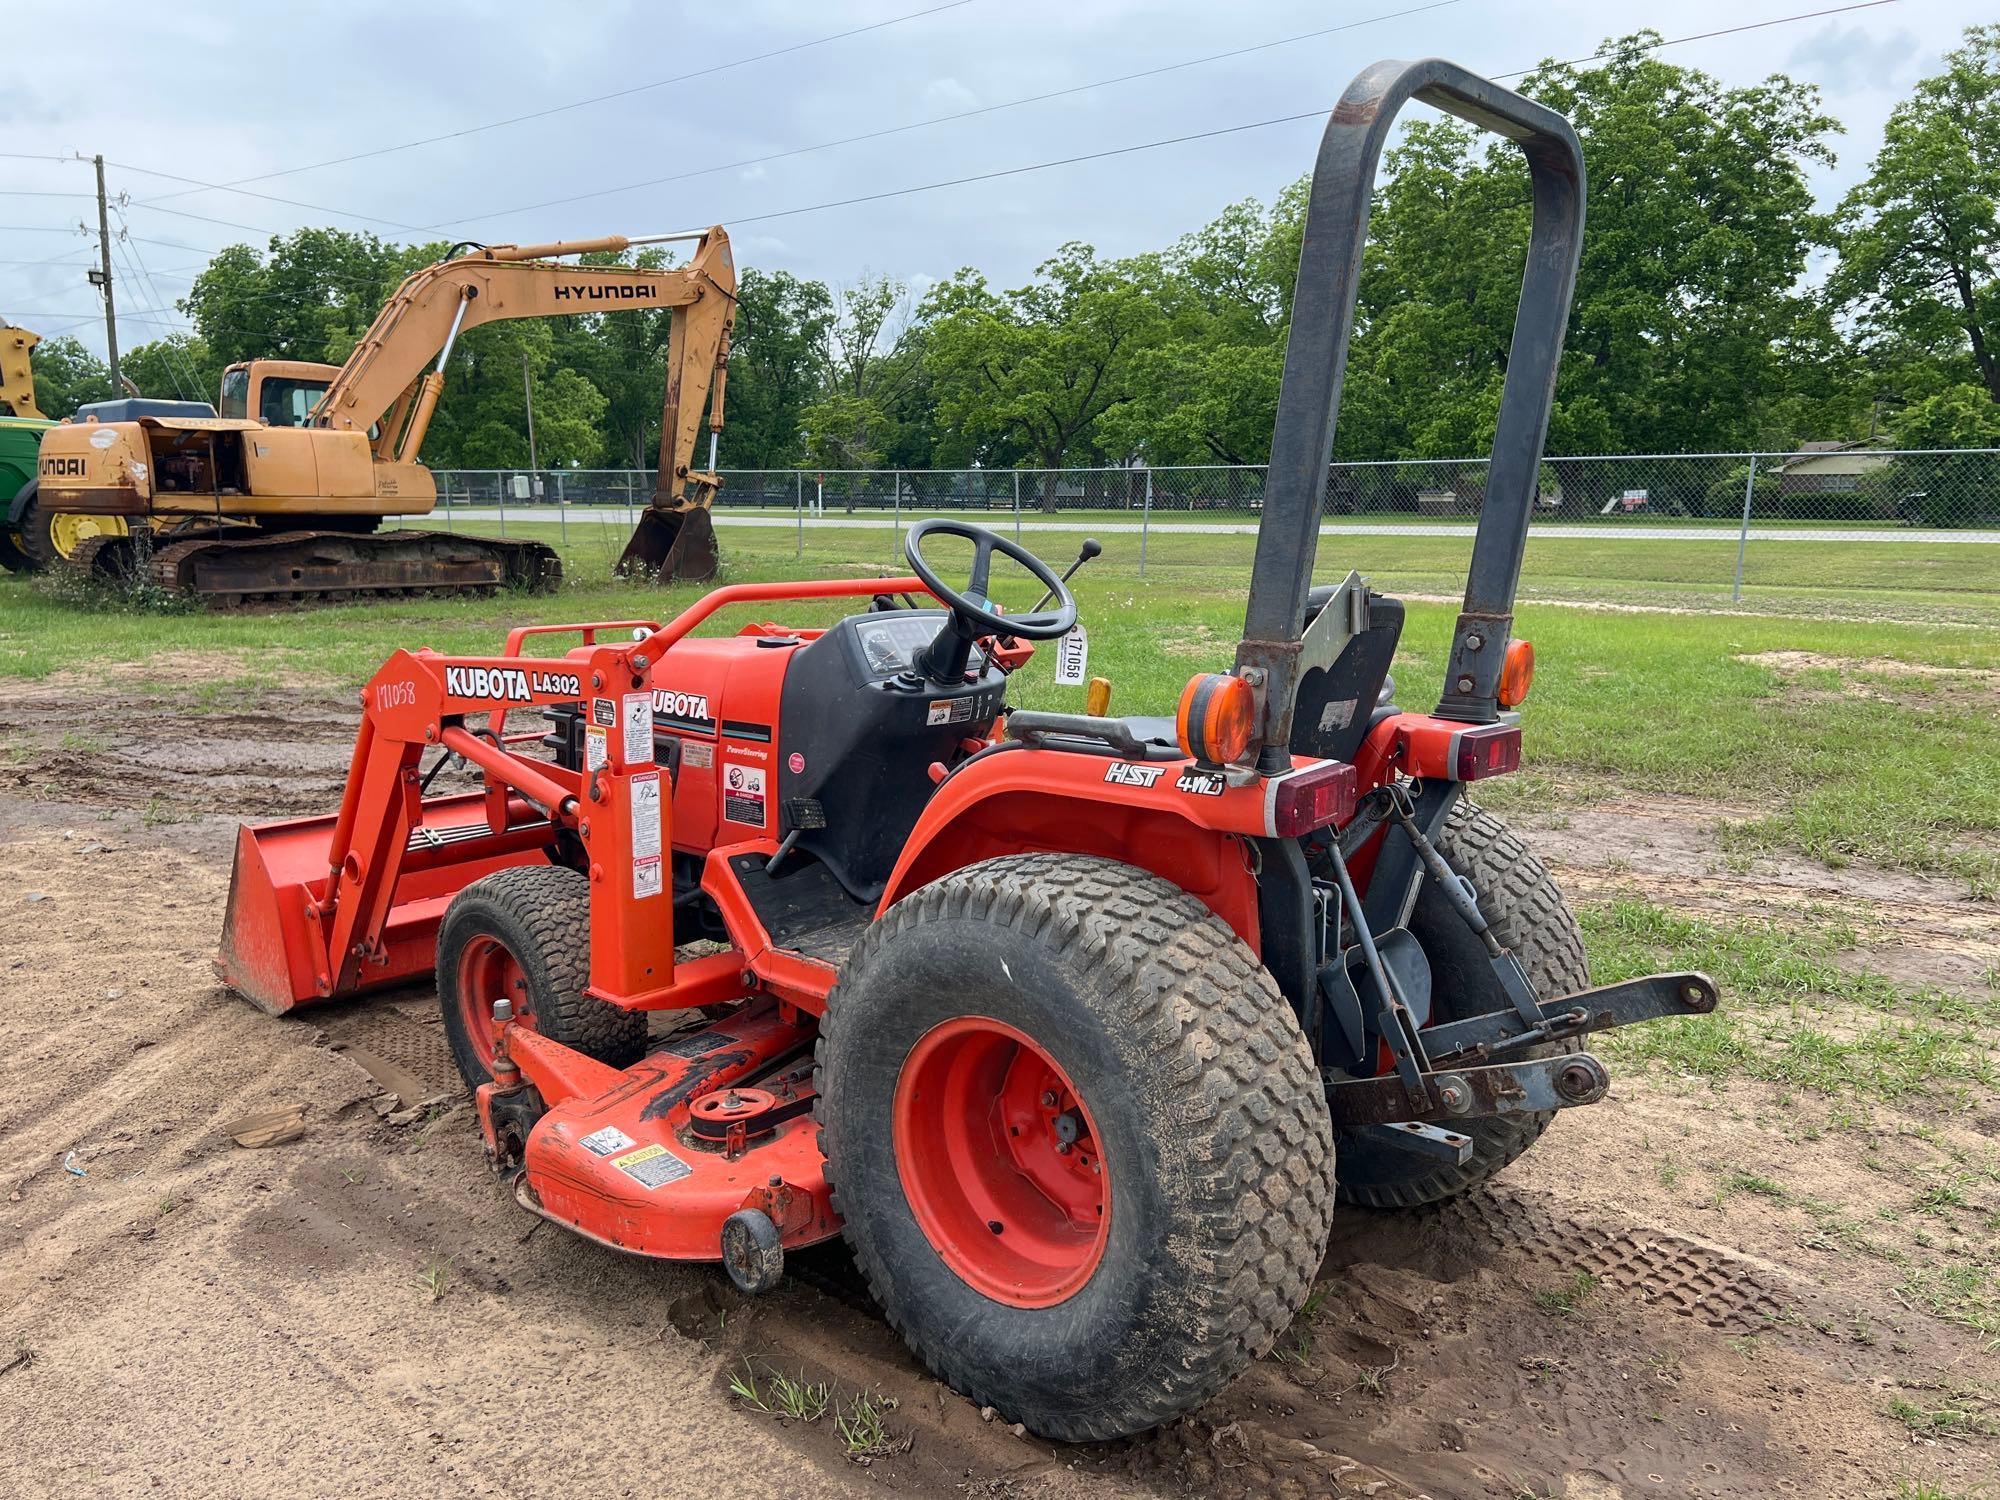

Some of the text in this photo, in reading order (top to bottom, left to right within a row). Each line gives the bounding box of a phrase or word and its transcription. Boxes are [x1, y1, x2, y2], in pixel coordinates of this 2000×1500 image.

[554, 285, 656, 300] HYUNDAI
[1066, 637, 1083, 679] 171058
[376, 681, 416, 712] 171058
[446, 666, 580, 701] KUBOTA LA302
[652, 690, 710, 721] UBOTA
[1104, 761, 1226, 796] HST 4WD
[627, 1145, 664, 1163] CAUTION
